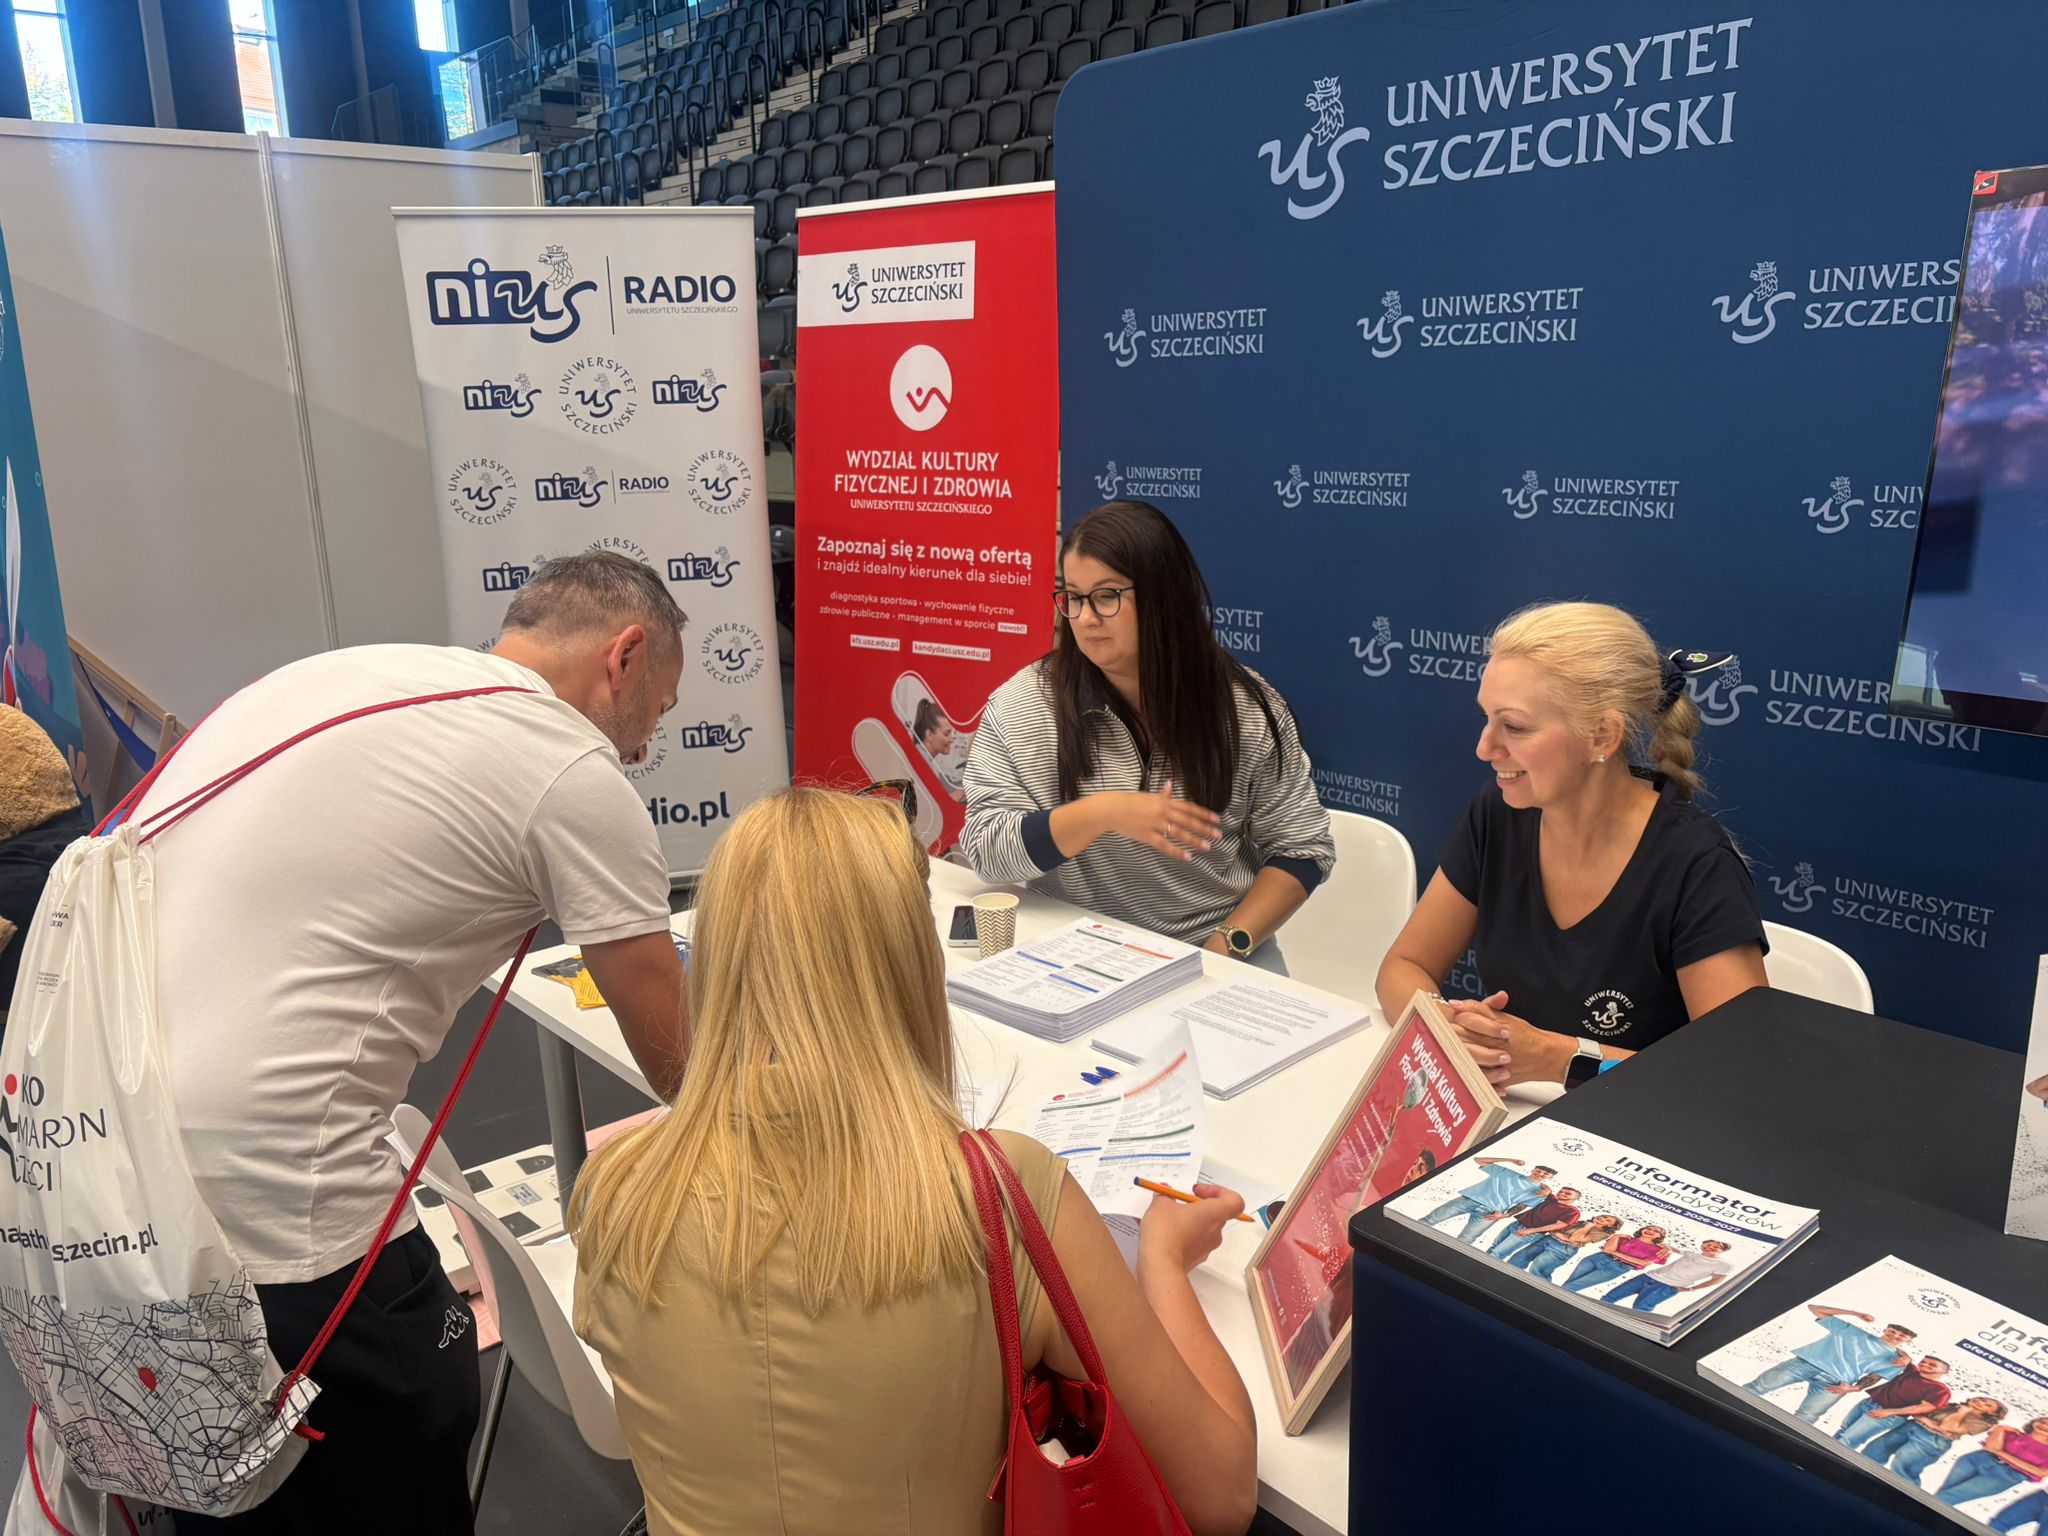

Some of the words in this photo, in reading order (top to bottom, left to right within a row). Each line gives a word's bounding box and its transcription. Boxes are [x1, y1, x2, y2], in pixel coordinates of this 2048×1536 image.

[1386, 17, 1754, 127] UNIWERSYTET
[1383, 92, 1737, 190] SZCZECIŃSKI
[871, 262, 965, 283] UNIWERSYTET
[1808, 259, 1960, 293] UNIWERS
[624, 275, 736, 304] RADIO
[871, 281, 963, 304] SZCZECIŃSKI
[1421, 287, 1584, 318] UNIWERSYTET
[627, 307, 679, 315] UNIWERSYTETU
[1151, 308, 1266, 333] UNIWERSYTET
[1420, 316, 1578, 347] SZCZECIŃSKI
[1150, 332, 1264, 358] SZCZECIŃSKI
[559, 357, 637, 395] UNIWERSYTET
[687, 450, 751, 482] UNIWERSYTET
[846, 450, 917, 470] WYDZIAŁ
[922, 452, 999, 472] KULTURY
[1126, 466, 1202, 482] UNIWERSYTET
[448, 458, 516, 492] UNIWERSYTET
[620, 476, 669, 491] RADIO
[835, 474, 918, 495] FIZYCZNEJ
[923, 478, 928, 495] I
[934, 477, 1012, 498] ZDROWIA
[1313, 470, 1410, 488] UNIWERSYTET
[1554, 477, 1679, 497] UNIWERSYTET
[1125, 481, 1201, 499] SZCZECIŃSKI
[1312, 486, 1408, 508] SZCZECIŃSKI
[851, 499, 914, 511] UNIWERSYTETU
[916, 500, 992, 515] SZCZECIŃSKIEGO
[1552, 497, 1675, 520] SZCZECIŃSKI
[817, 536, 886, 559] Zapoznaj
[891, 540, 913, 561] się
[917, 546, 925, 558] z
[930, 547, 975, 565] nową
[979, 546, 1032, 570] ofertą
[817, 559, 821, 570] i
[824, 559, 860, 576] znajdź
[863, 564, 906, 579] idealny
[910, 565, 963, 581] kierunek
[966, 569, 986, 582] dla
[989, 571, 1031, 586] siebie!
[830, 591, 878, 604] diagnostyka
[880, 595, 917, 608] sportowa
[924, 600, 976, 612] wychowanie
[979, 604, 1014, 616] fizyczne
[820, 605, 849, 616] zdrowie
[852, 609, 890, 620] publiczne
[898, 613, 952, 626] management
[964, 619, 995, 630] sporcie
[701, 623, 764, 653] UNIWERSYTET
[1319, 786, 1399, 816] ZCZECIŃSKI
[1834, 876, 1994, 926] UNIWERSYTET
[1831, 898, 1987, 949] SZCZECIŃSKI
[1584, 990, 1634, 1009] UNIWERSYTET
[1411, 1033, 1442, 1083] Wydział
[1435, 1074, 1466, 1127] Kultury
[1425, 1098, 1452, 1147] Zdrowia
[1605, 1164, 1637, 1181] dla
[1641, 1178, 1782, 1231] kandydatów
[1615, 1156, 1776, 1218] Informator
[1593, 1175, 1622, 1191] oferta
[1623, 1188, 1682, 1214] edukacyjna
[1683, 1210, 1742, 1233] 2026-2027
[1962, 1343, 2002, 1363] oferta
[1978, 1331, 2019, 1352] dla
